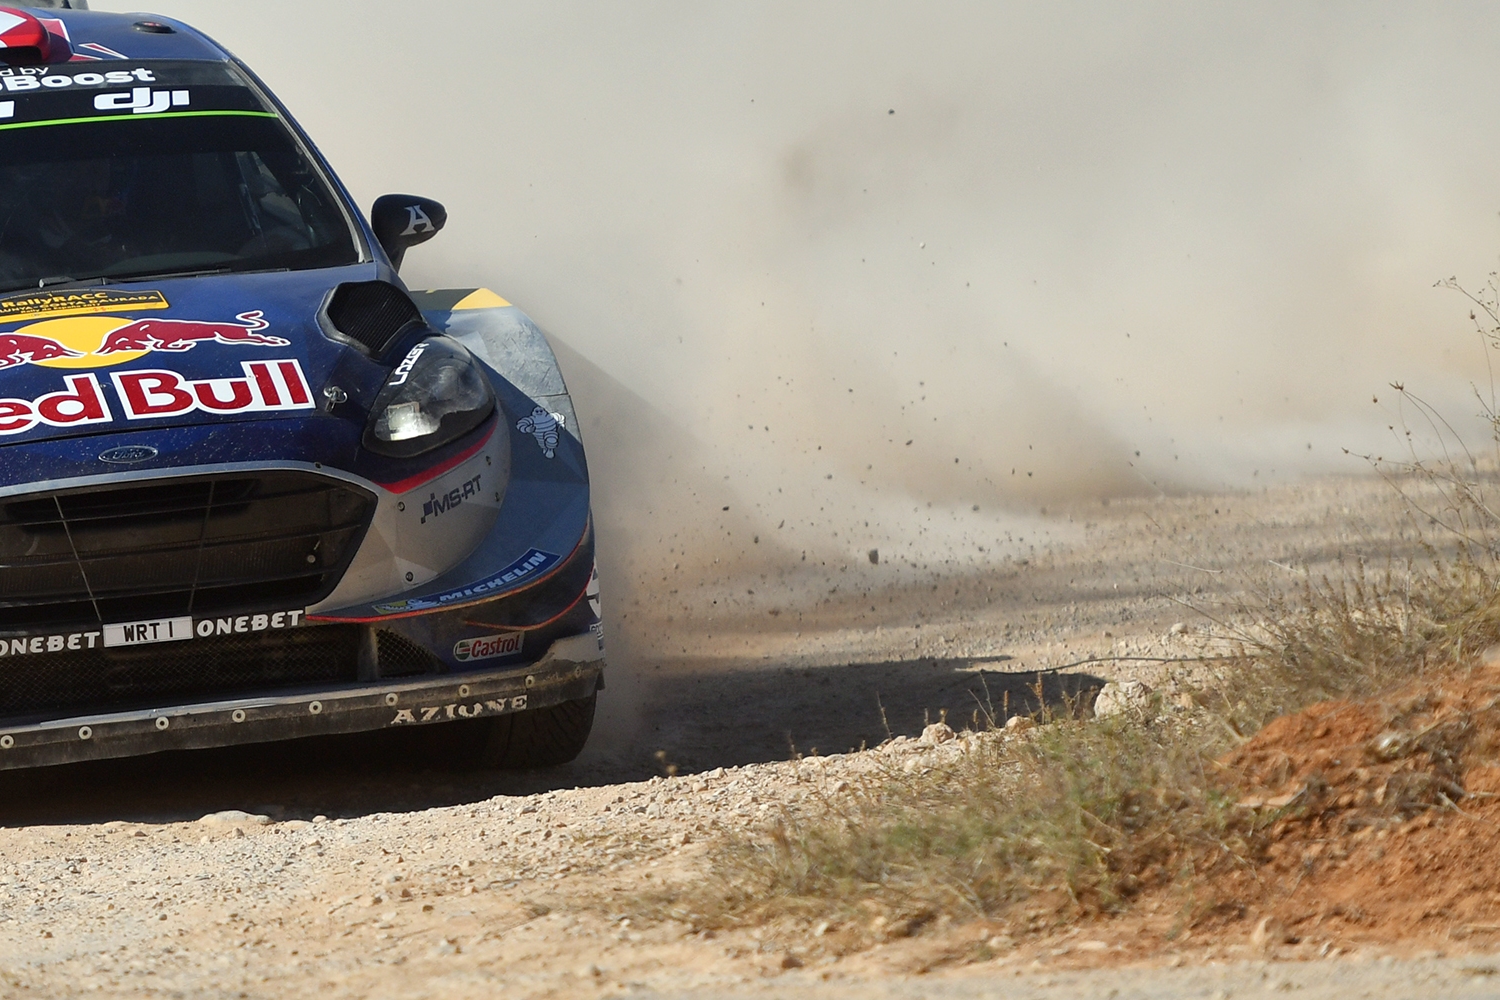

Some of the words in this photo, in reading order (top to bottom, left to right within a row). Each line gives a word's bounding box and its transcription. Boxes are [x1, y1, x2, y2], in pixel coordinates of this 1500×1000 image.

[19, 65, 49, 77] by
[1, 292, 109, 308] RallyRACC
[88, 295, 159, 305] DAURADA
[120, 361, 310, 416] Bull
[440, 551, 548, 602] MICHELIN
[123, 622, 161, 643] WRT
[196, 609, 304, 638] ONEBET
[471, 635, 521, 658] Castrol
[390, 694, 528, 725] AZIONE
